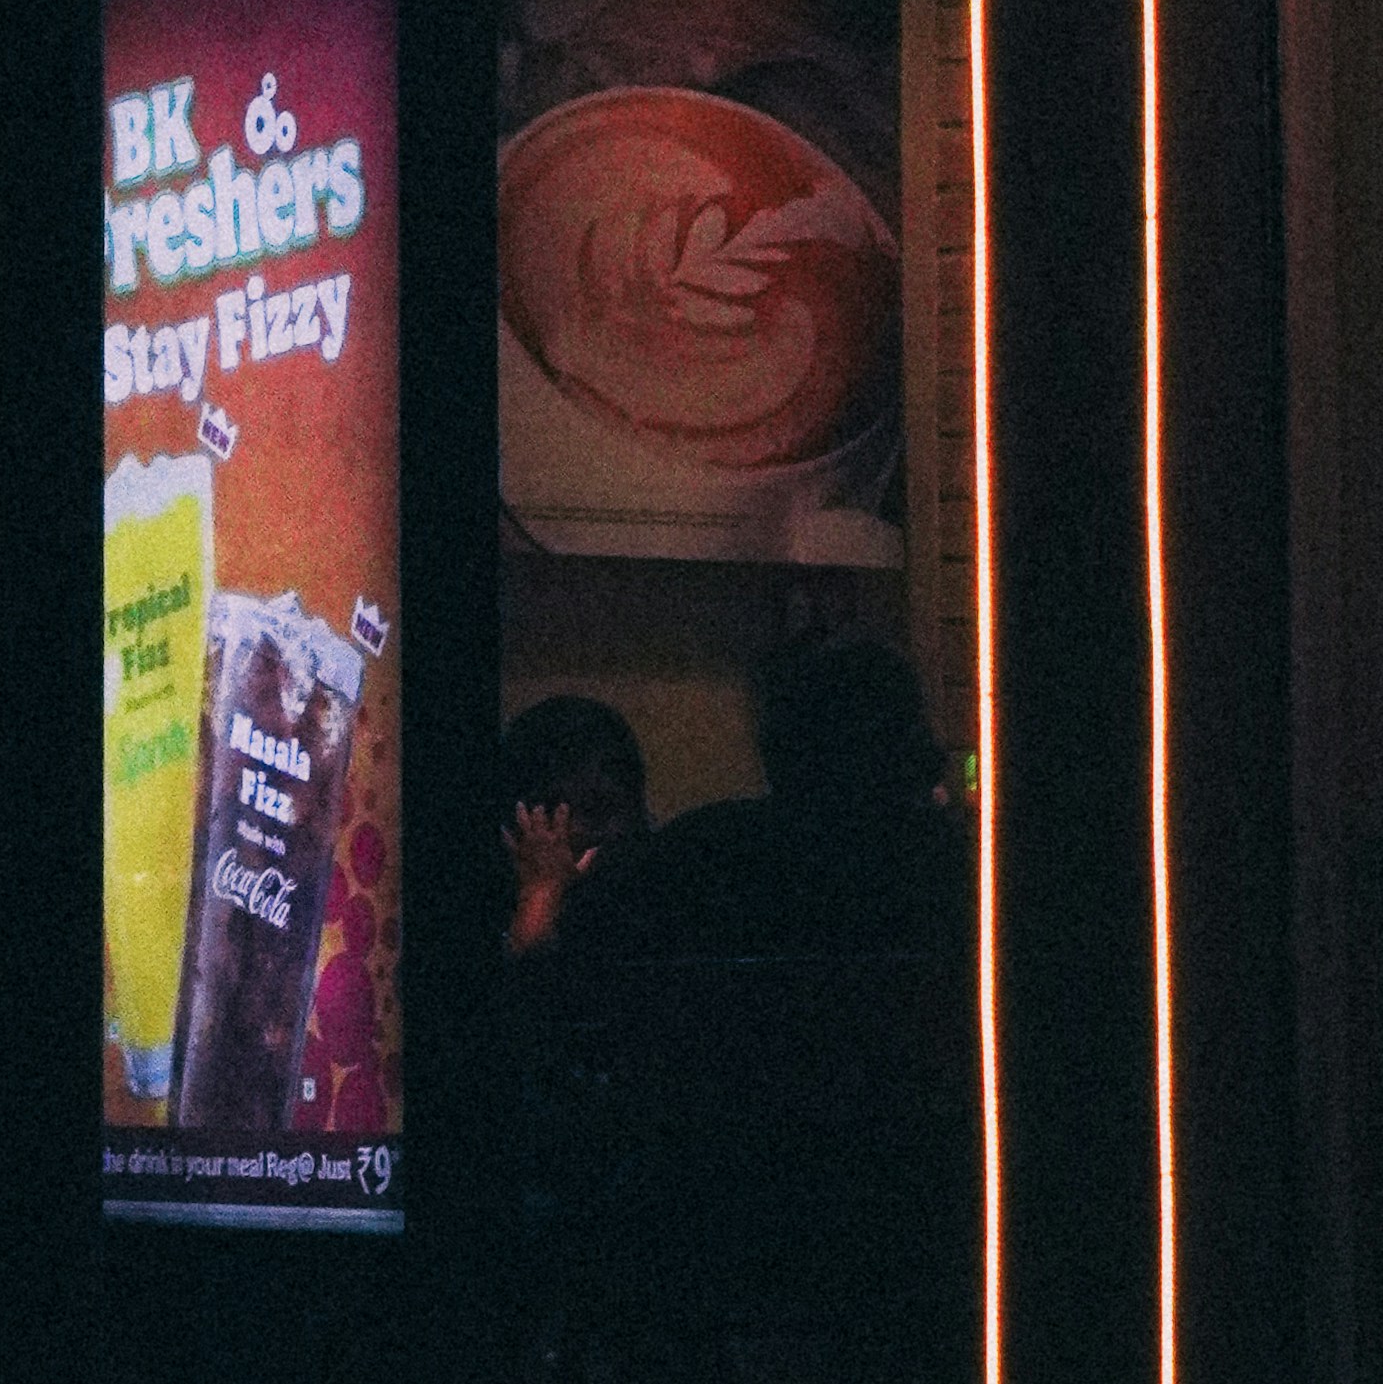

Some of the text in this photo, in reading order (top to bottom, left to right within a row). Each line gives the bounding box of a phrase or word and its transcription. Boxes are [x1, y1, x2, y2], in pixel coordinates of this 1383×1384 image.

[111, 76, 200, 189] BK
[104, 137, 366, 297] reshers
[103, 273, 352, 405] Stay Fizzy
[107, 571, 191, 647] ropical
[230, 712, 311, 783] Masala
[239, 767, 296, 825] Fizz
[185, 1154, 225, 1183] your
[227, 1151, 264, 1179] meal
[317, 1154, 353, 1181] Just
